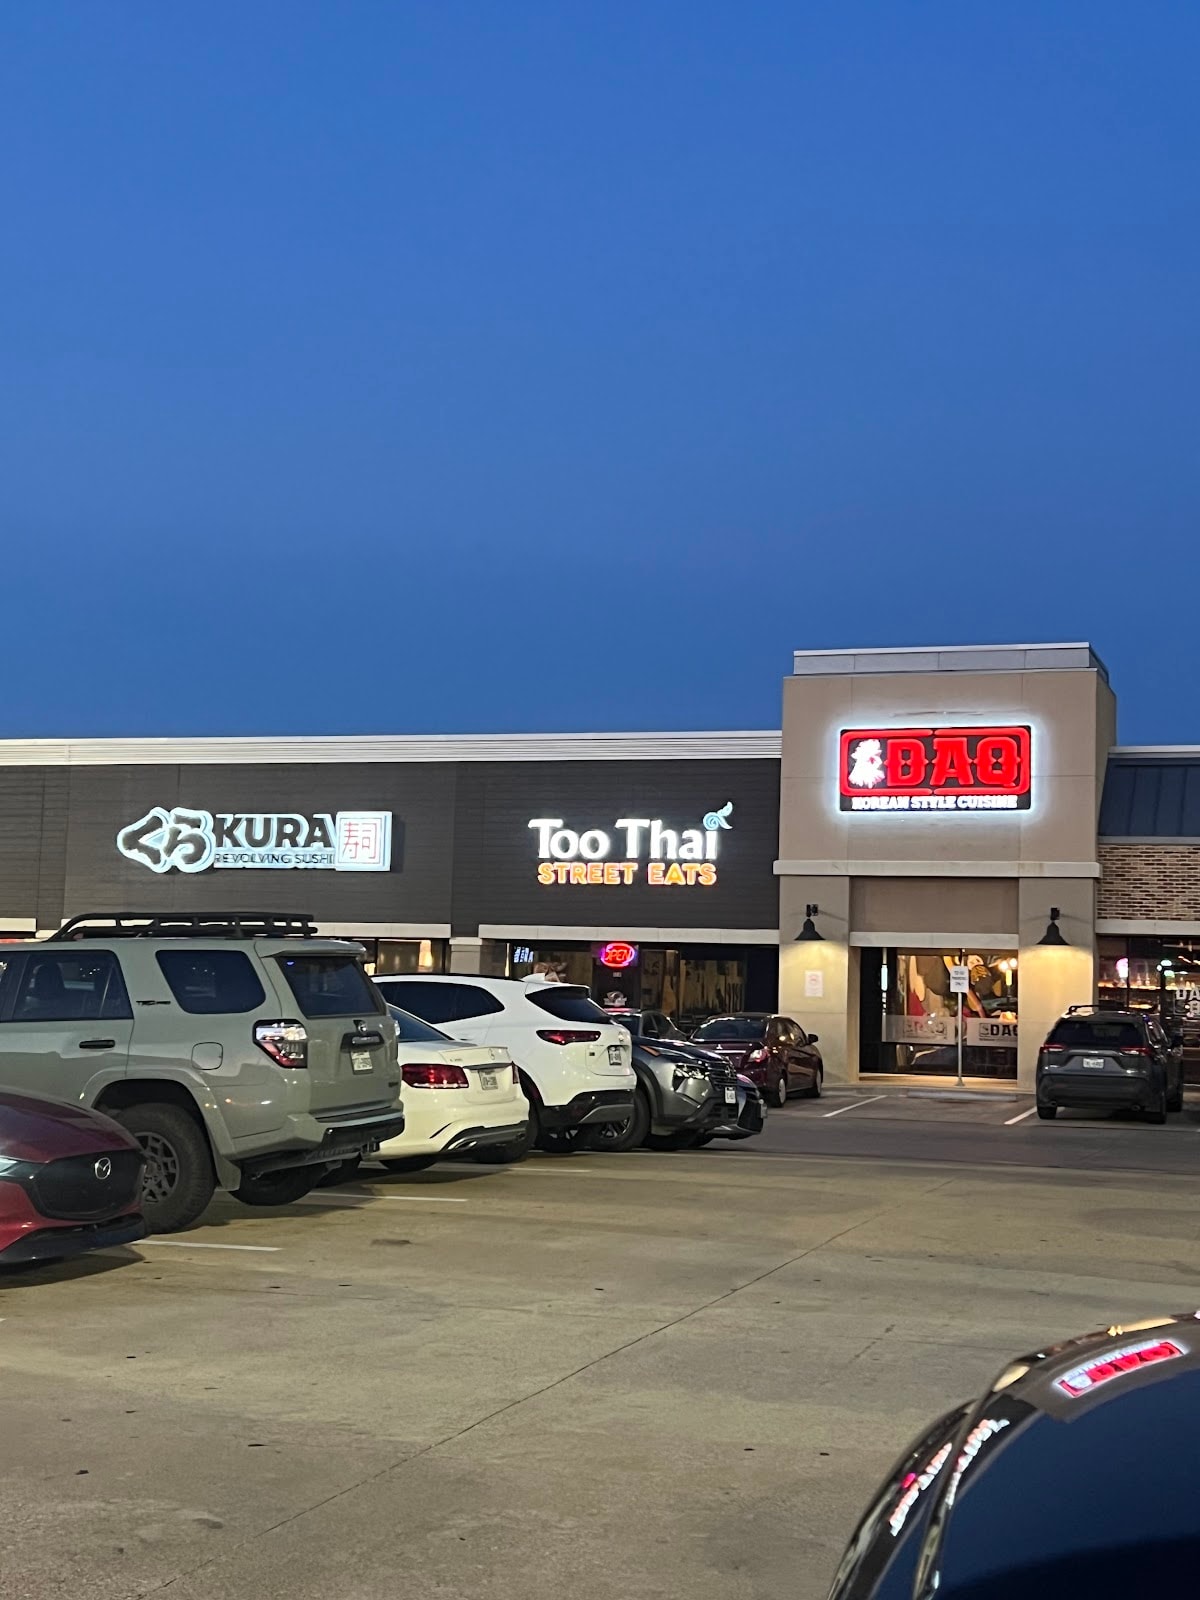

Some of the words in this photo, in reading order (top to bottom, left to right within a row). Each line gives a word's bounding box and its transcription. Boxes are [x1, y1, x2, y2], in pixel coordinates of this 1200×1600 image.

[884, 737, 1021, 788] DAQ
[851, 796, 910, 810] KOREAN
[911, 796, 956, 809] STYLE
[957, 795, 1018, 809] CUISINE
[214, 814, 335, 848] KURA
[527, 818, 611, 860] Too
[614, 818, 719, 860] Thai
[215, 853, 291, 864] REVOLVING
[294, 853, 335, 864] SUSHI
[537, 862, 639, 885] STREET
[648, 862, 717, 885] EATS
